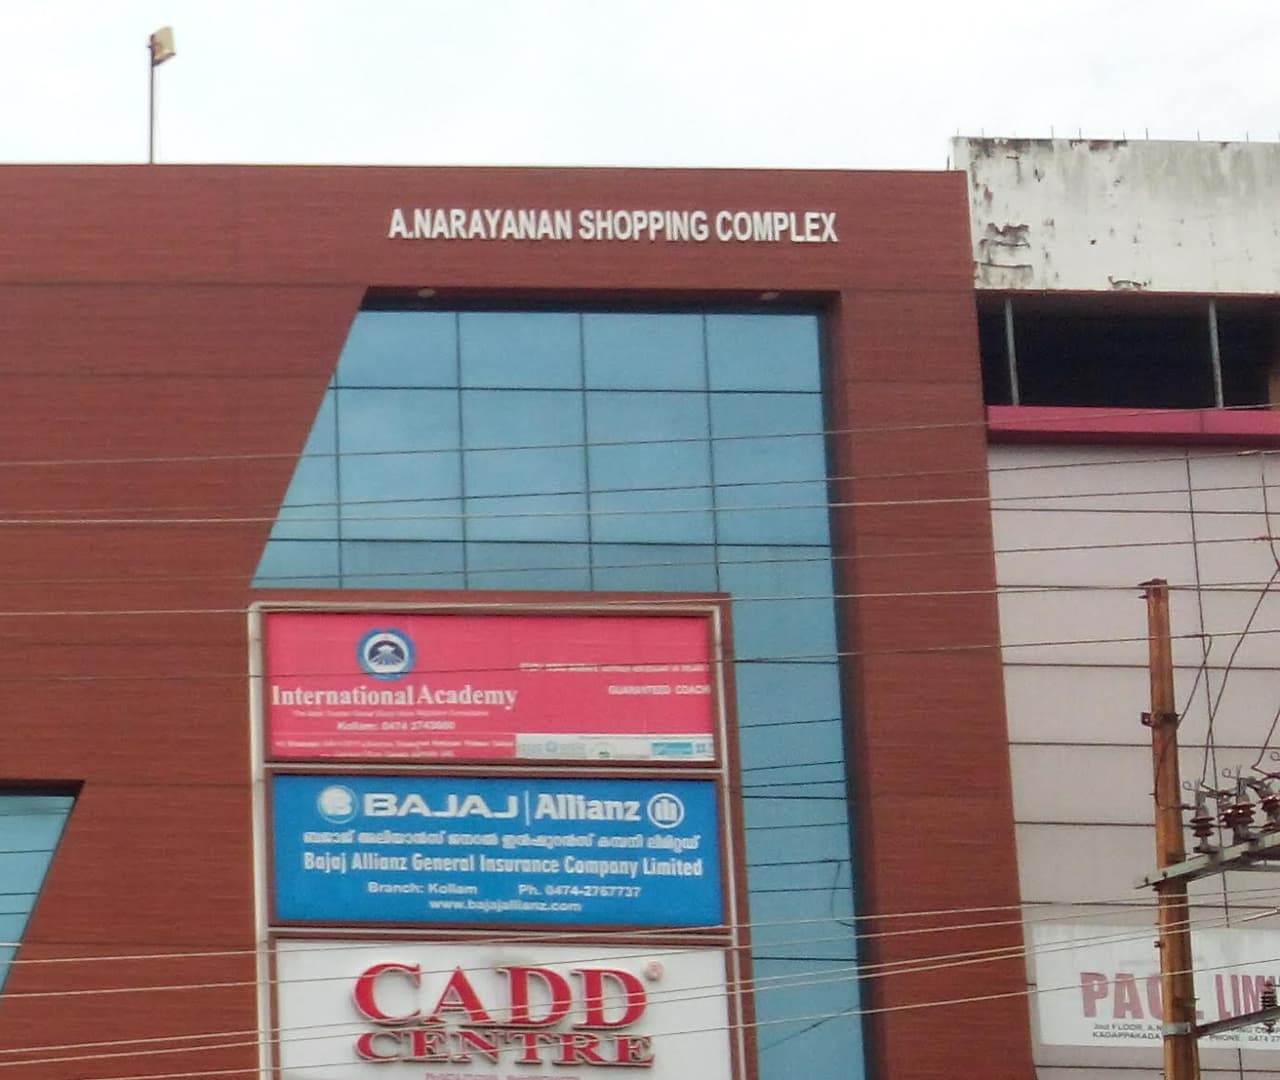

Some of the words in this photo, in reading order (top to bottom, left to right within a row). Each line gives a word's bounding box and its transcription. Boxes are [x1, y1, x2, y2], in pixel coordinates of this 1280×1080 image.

[387, 208, 572, 240] A.NARAYANAN
[578, 209, 707, 242] SHOPPING
[715, 211, 839, 243] COMPLEX
[272, 685, 414, 706] International
[416, 684, 518, 711] Academy
[363, 793, 519, 818] BAJAJ
[535, 791, 641, 822] Allianz
[304, 853, 347, 874] Bajaj
[351, 853, 408, 871] Allianz
[412, 853, 475, 872] General
[480, 855, 560, 874] Insurance
[564, 856, 639, 878] Company
[643, 858, 703, 876] Limited
[367, 881, 423, 893] Branch:
[428, 883, 477, 895] Kollam
[352, 961, 648, 1030] CADD
[354, 1030, 656, 1068] CENTRE
